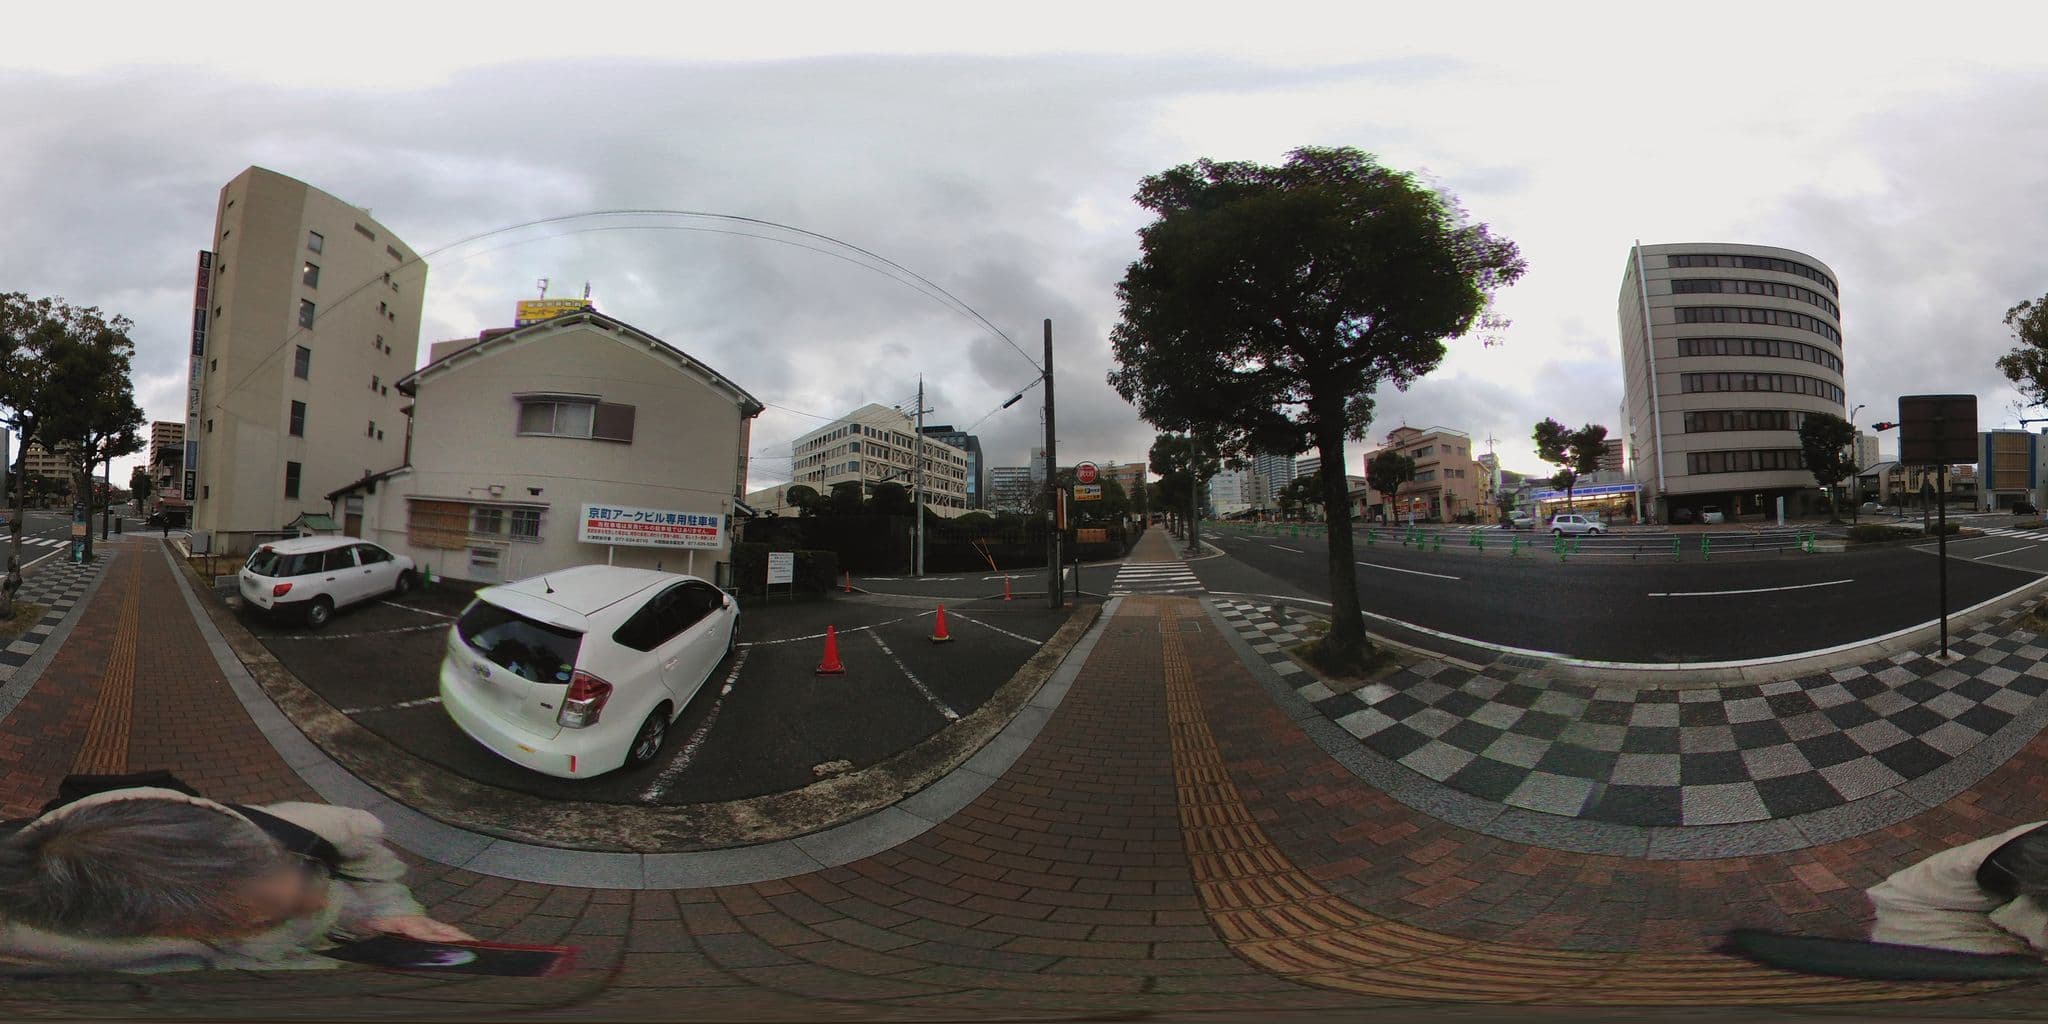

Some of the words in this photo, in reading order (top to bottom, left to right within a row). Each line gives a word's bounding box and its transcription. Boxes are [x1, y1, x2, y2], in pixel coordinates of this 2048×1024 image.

[589, 508, 718, 527] 京町アークビル専用駐車場
